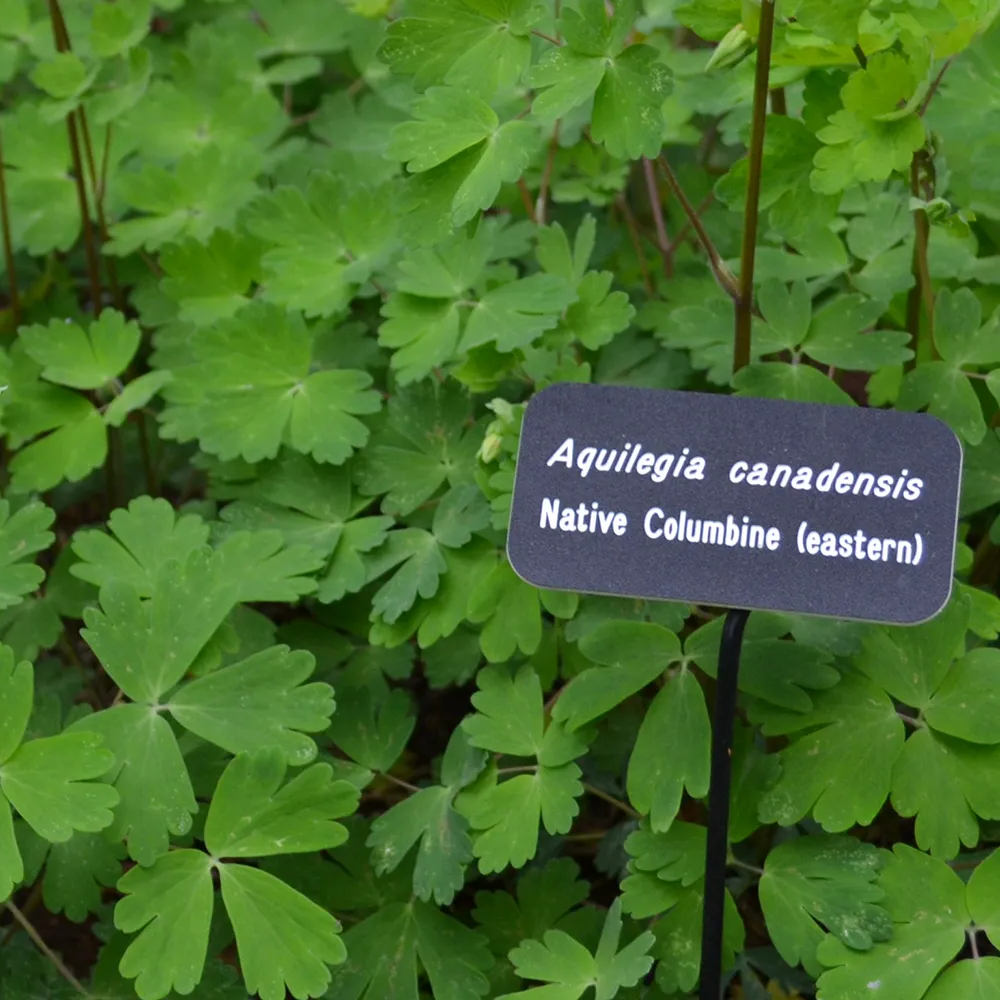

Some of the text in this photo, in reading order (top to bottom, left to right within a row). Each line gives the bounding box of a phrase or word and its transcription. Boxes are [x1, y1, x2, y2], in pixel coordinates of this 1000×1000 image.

[546, 437, 924, 501] Aquilegia canadensis
[539, 497, 924, 566] Native Columbine (eastern)
